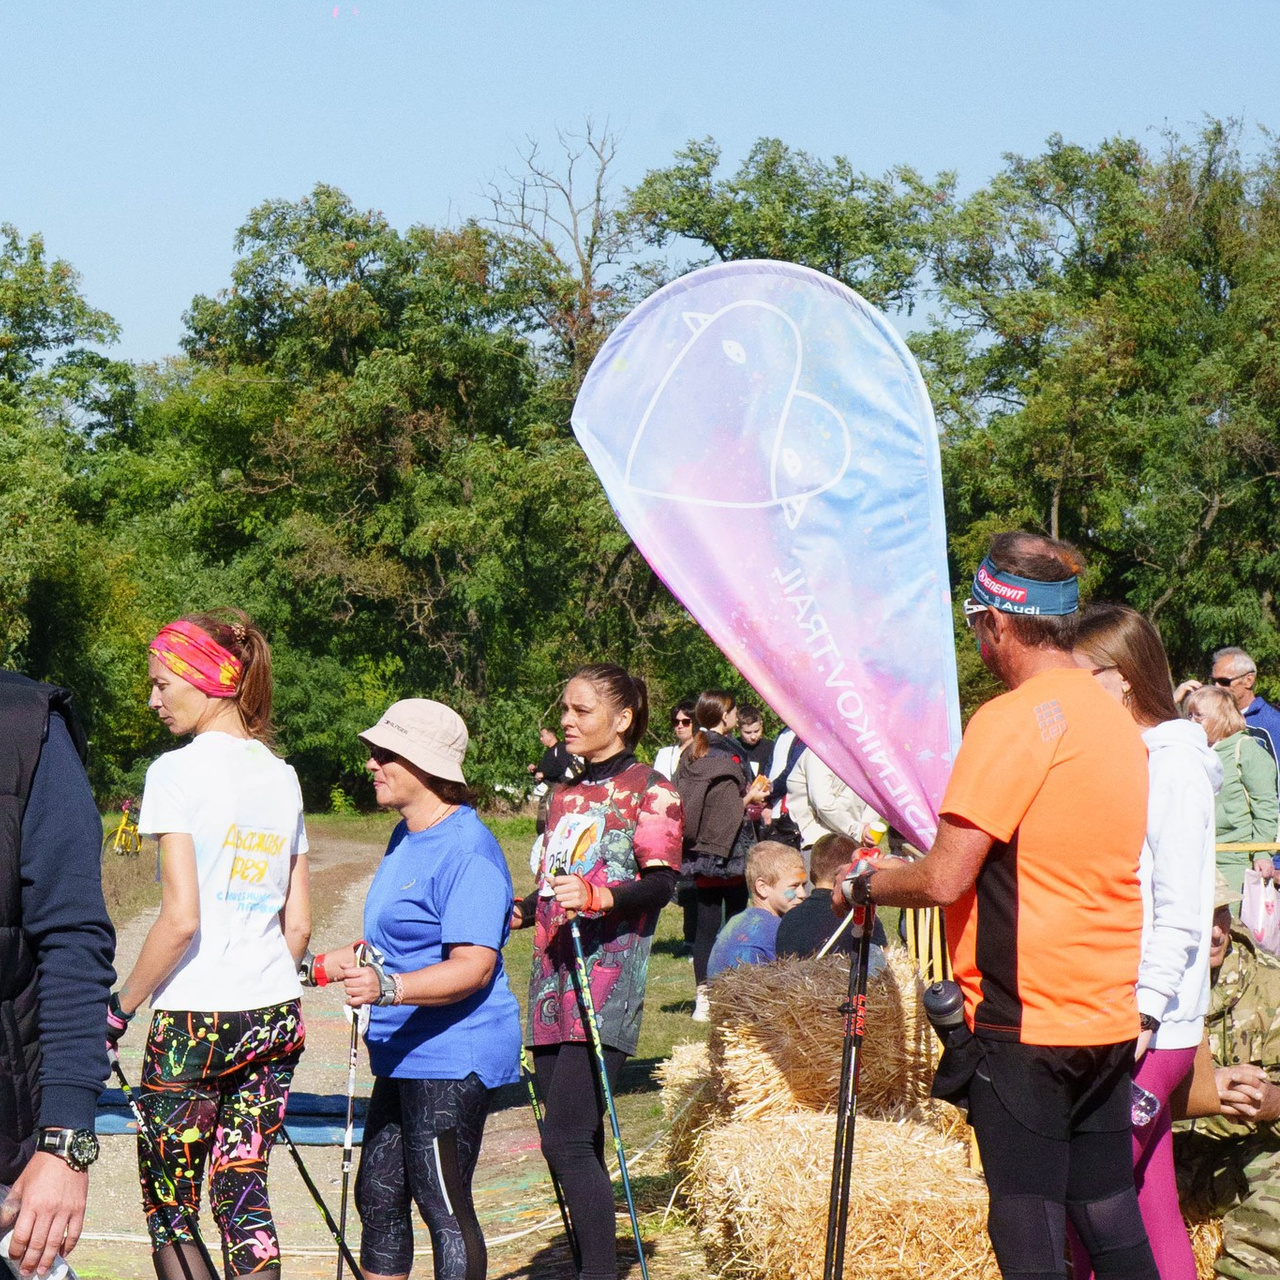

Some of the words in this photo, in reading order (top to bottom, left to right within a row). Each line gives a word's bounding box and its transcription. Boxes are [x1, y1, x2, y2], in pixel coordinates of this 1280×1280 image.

[984, 578, 1025, 600] ENERVIT
[1002, 601, 1040, 615] Audi
[549, 849, 568, 873] 254
[855, 994, 865, 1036] LEKI
